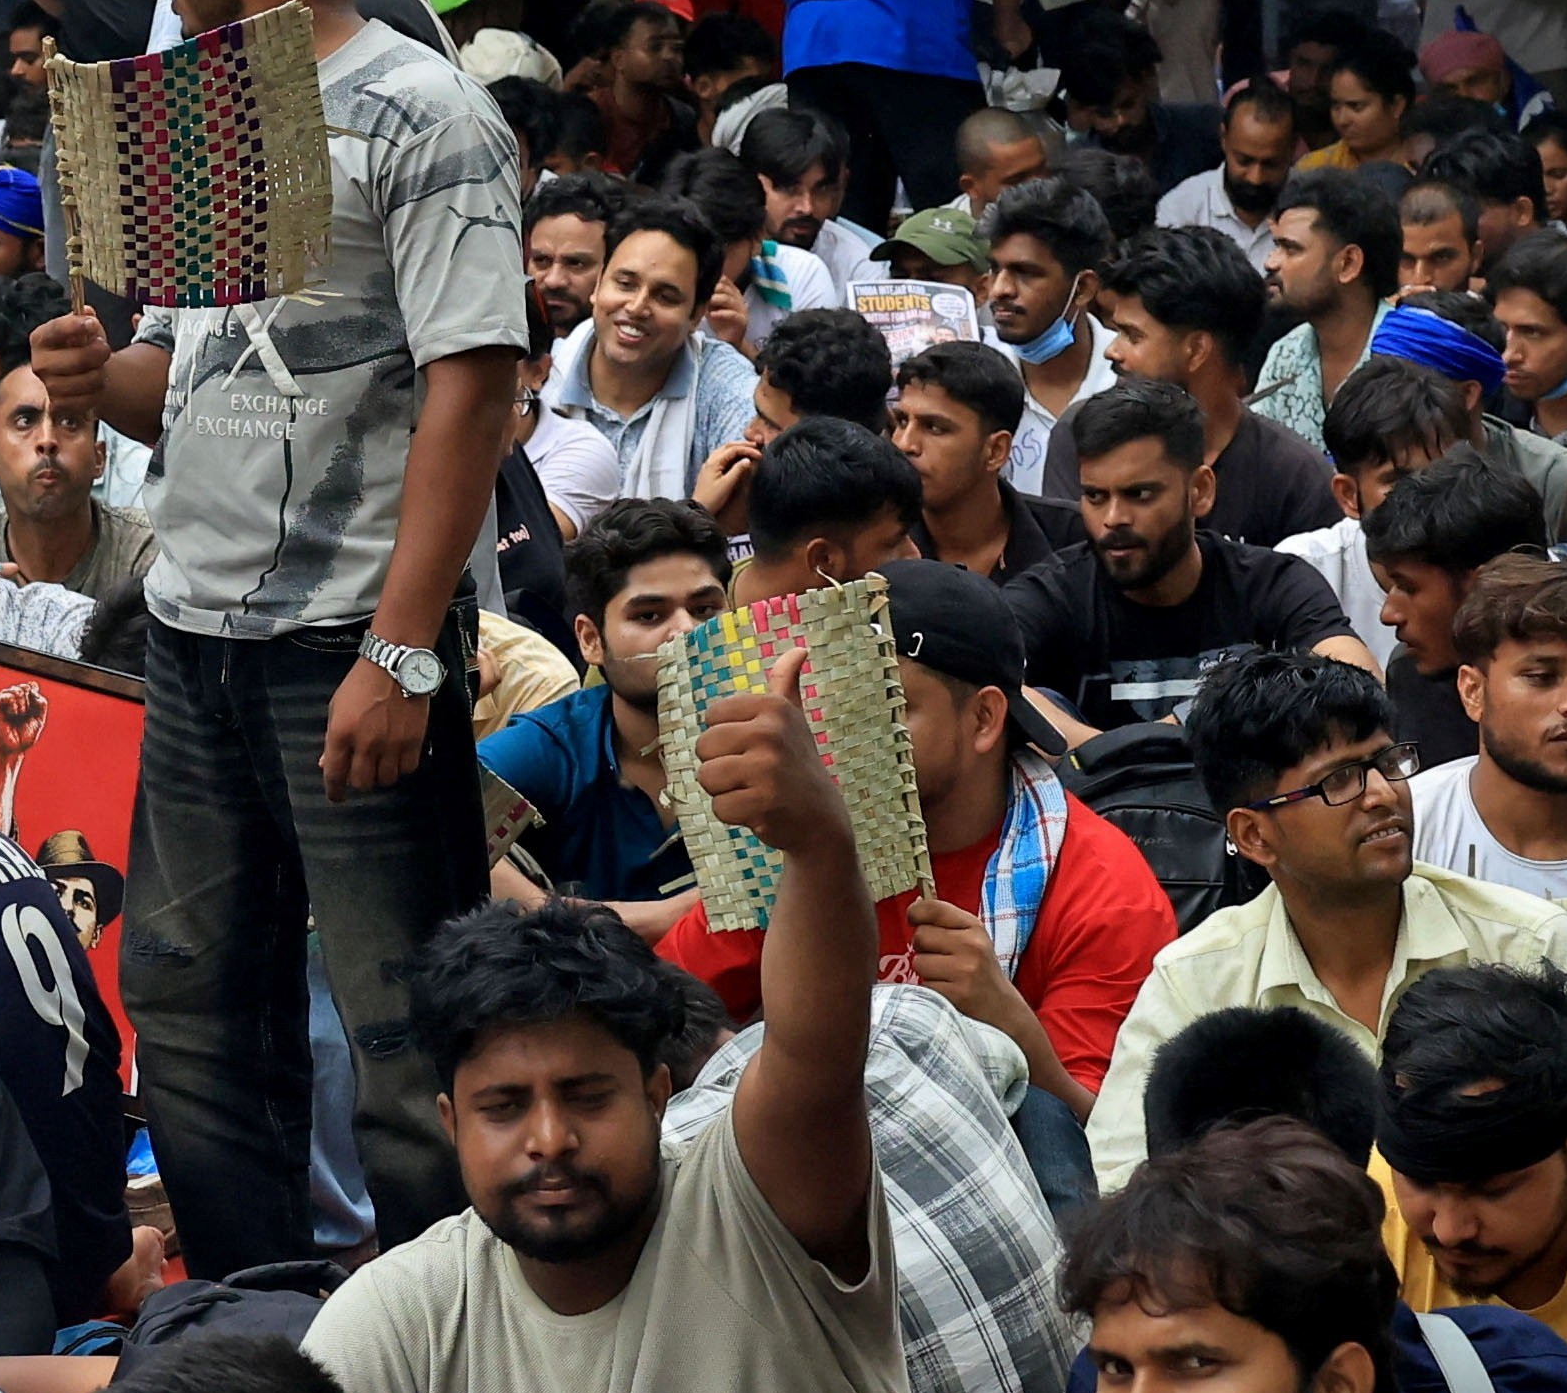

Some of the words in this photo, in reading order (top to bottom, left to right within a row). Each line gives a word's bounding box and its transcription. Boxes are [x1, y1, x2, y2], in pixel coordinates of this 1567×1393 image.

[857, 295, 932, 314] STUDENTS
[230, 393, 330, 416] EXCHANGE
[195, 415, 297, 440] EXCHANGE
[0, 902, 90, 1098] 9
